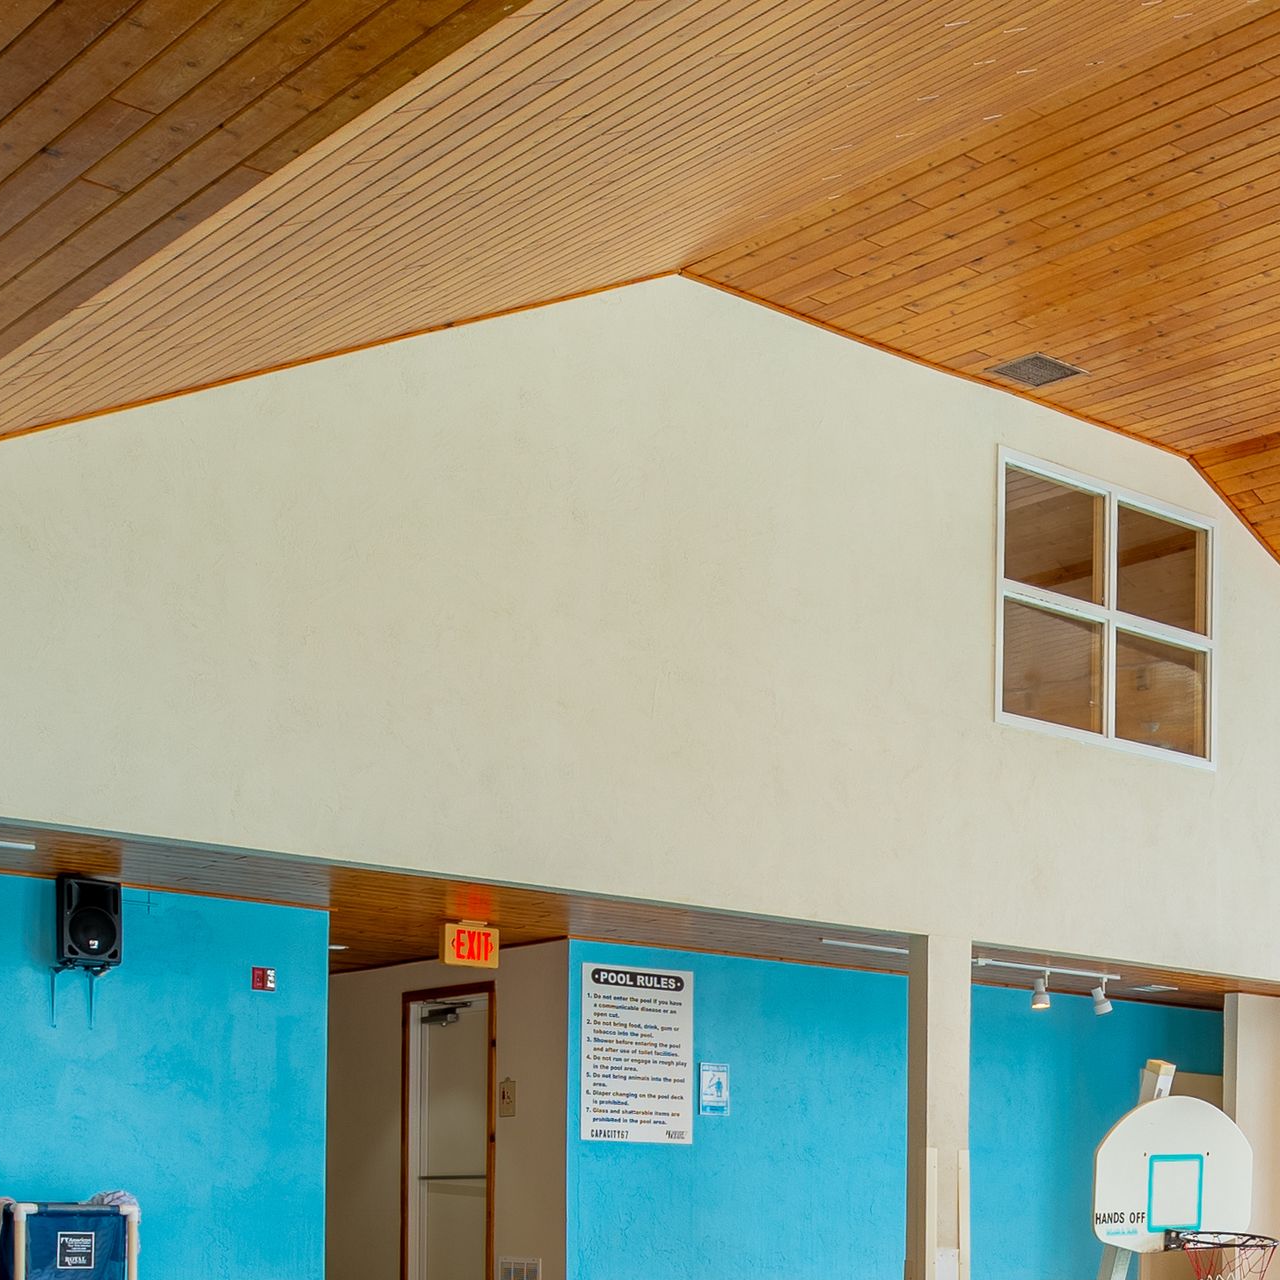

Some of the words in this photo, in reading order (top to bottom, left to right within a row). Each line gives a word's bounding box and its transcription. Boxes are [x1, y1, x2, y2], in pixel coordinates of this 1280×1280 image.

[456, 930, 491, 961] EXIT
[600, 972, 633, 985] POOL
[637, 976, 675, 989] RULES
[1096, 1212, 1125, 1224] HANDS
[1130, 1212, 1146, 1224] OFF
